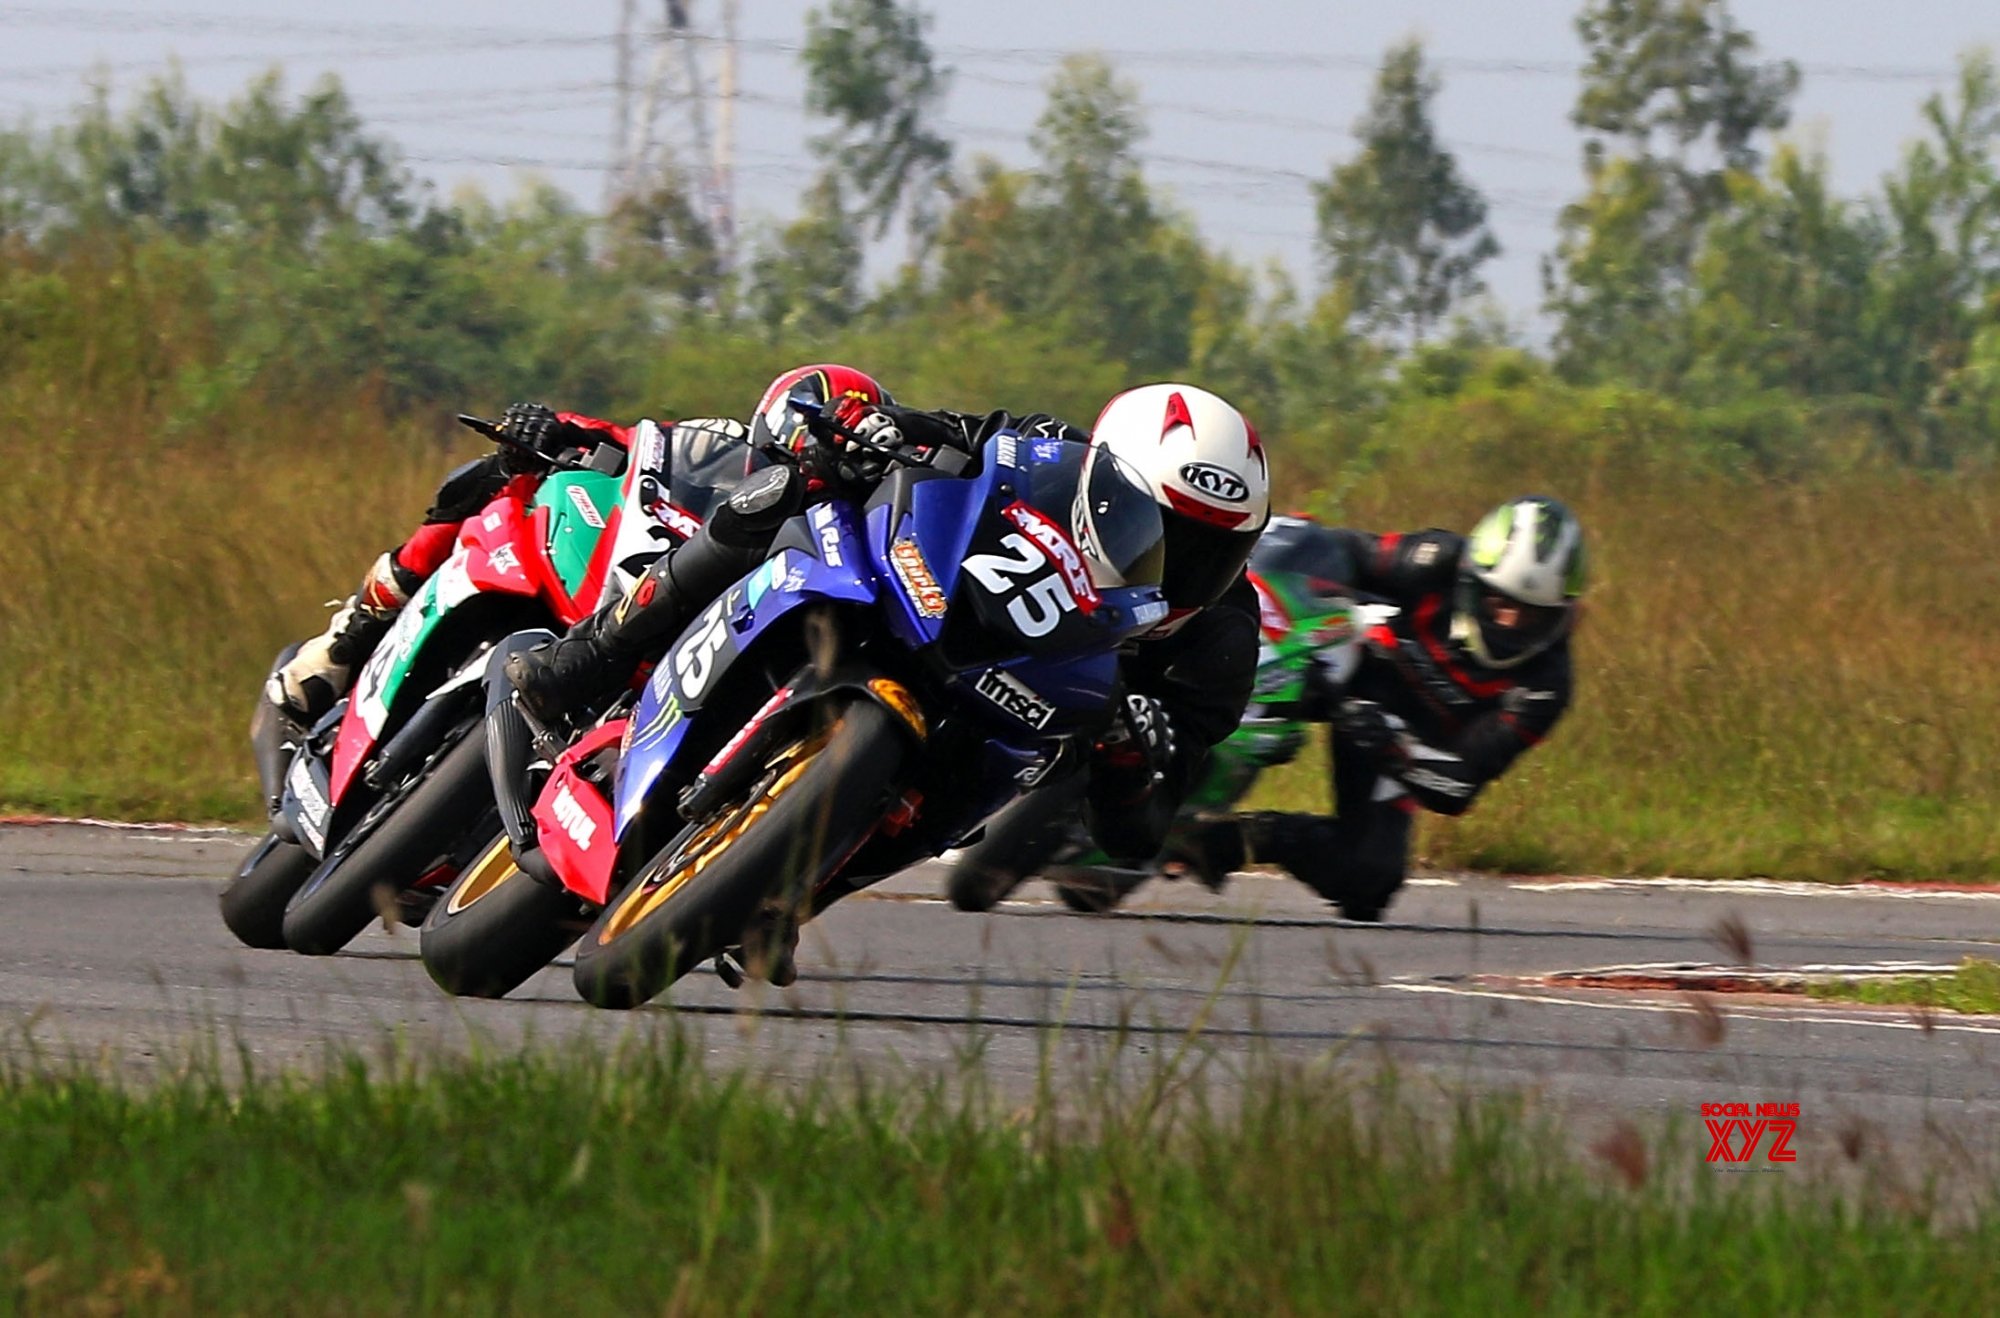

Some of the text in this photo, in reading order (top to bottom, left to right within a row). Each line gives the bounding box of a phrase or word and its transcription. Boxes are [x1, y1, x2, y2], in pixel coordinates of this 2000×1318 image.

[1186, 465, 1245, 498] KYT
[961, 533, 1077, 637] 25
[1012, 506, 1098, 604] MRF
[551, 784, 597, 851] MOTUL
